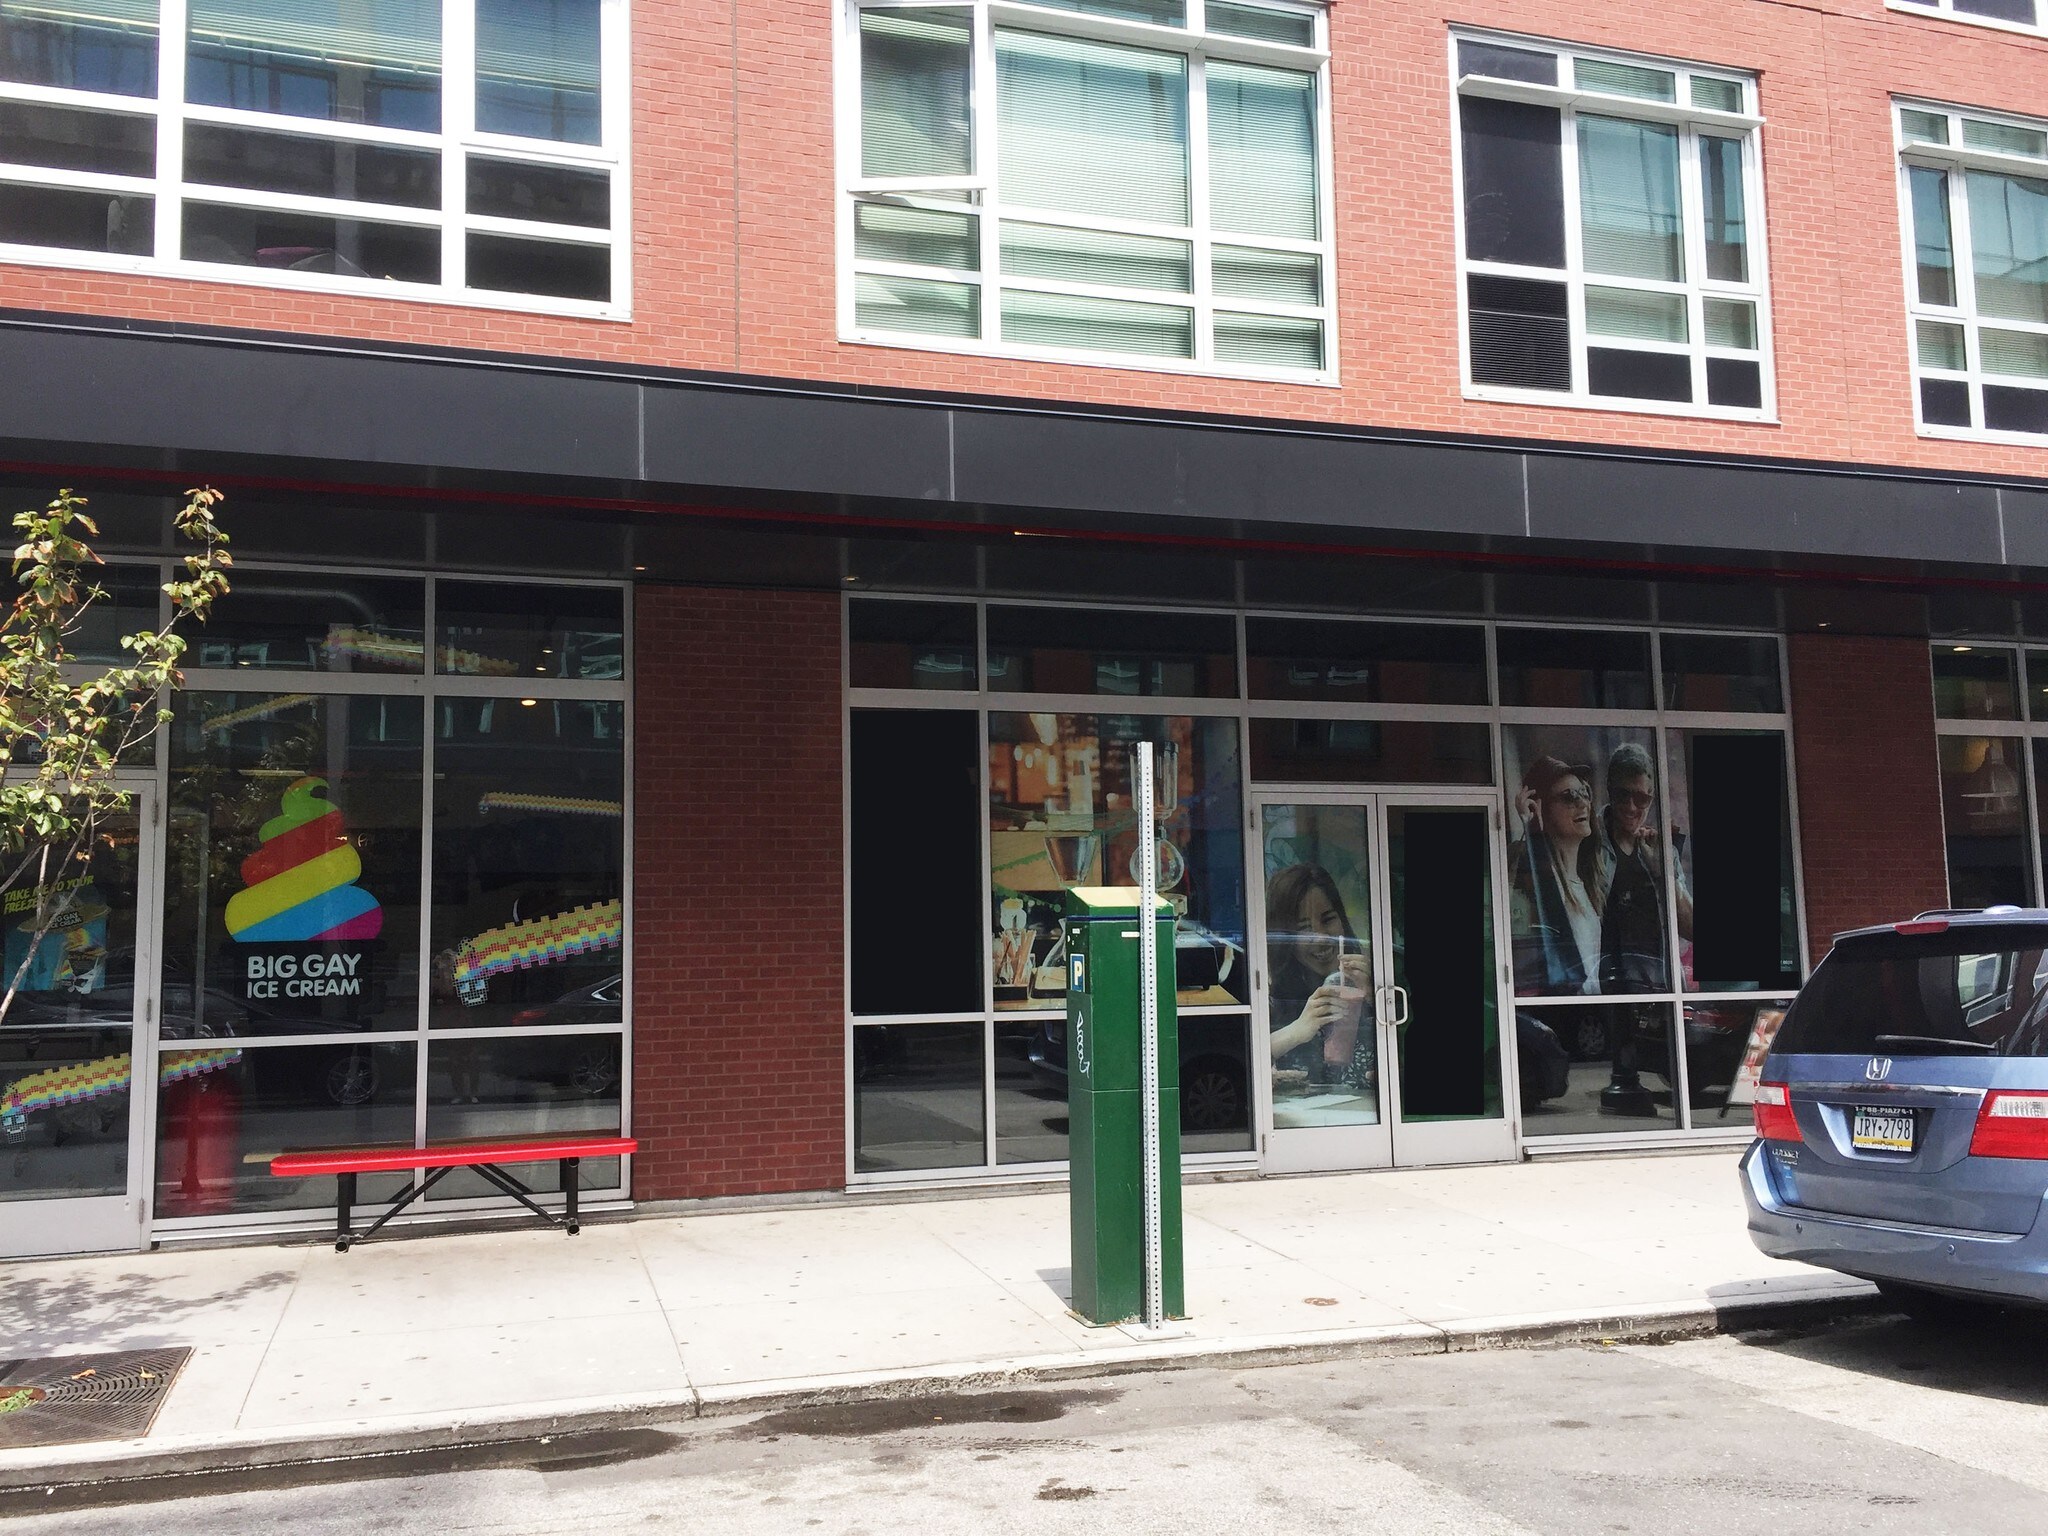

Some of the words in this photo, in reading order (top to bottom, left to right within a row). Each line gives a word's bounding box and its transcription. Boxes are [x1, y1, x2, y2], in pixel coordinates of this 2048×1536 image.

[5, 888, 30, 903] TAKE
[67, 875, 94, 890] YOUR
[247, 955, 298, 979] BIG
[302, 953, 362, 978] GAY
[1074, 960, 1083, 986] P
[247, 980, 279, 998] ICE
[285, 978, 360, 998] CREAM
